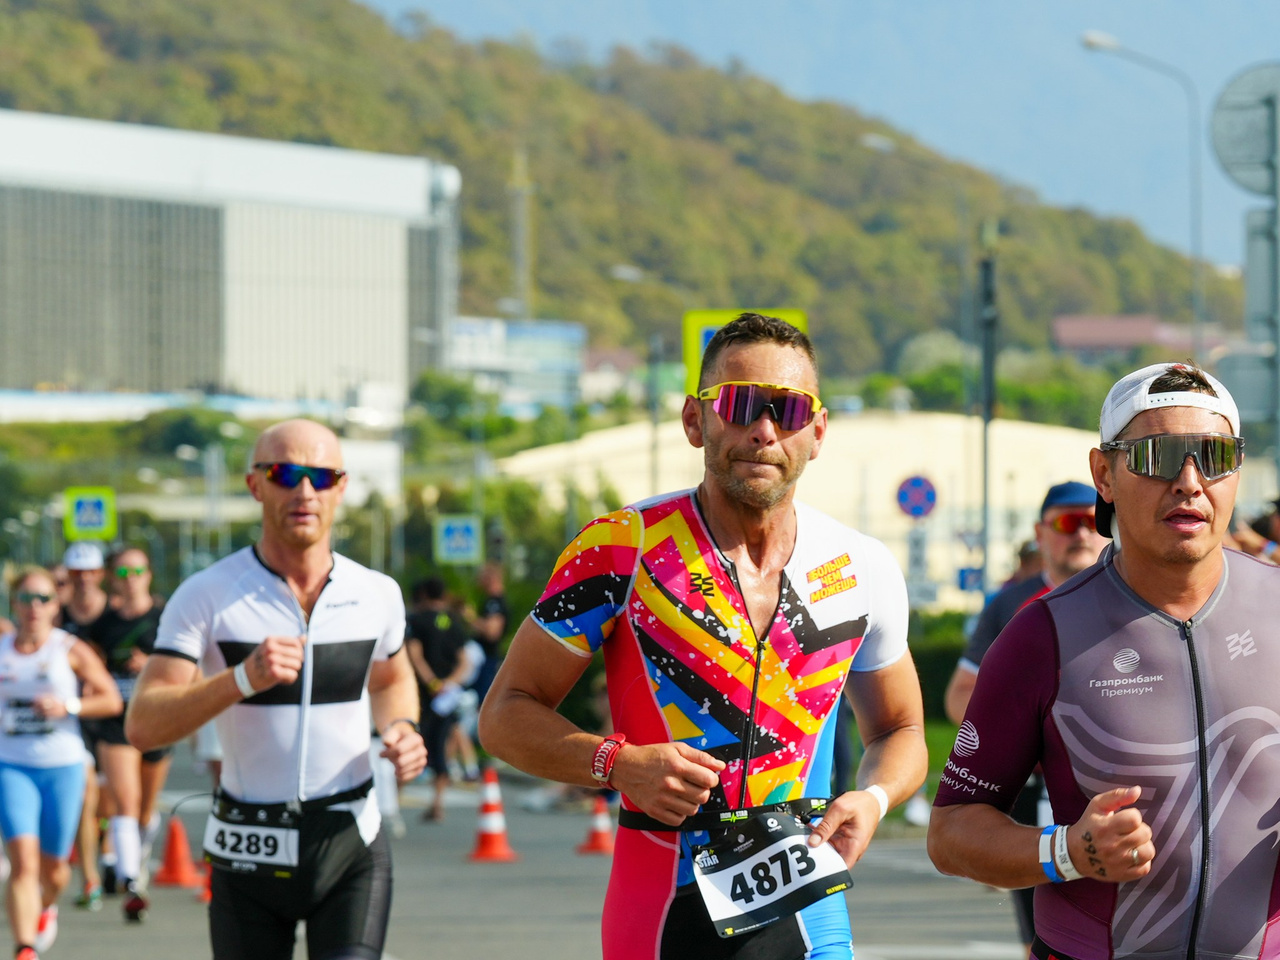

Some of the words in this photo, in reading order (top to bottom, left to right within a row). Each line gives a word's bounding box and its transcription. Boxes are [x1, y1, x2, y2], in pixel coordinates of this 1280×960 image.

[807, 553, 851, 583] БОЛЬШЕ
[820, 569, 842, 586] ЧЕМ
[810, 576, 857, 604] МОЖЕШЬ
[1089, 674, 1164, 688] Газпромбанк
[1101, 686, 1153, 698] Премиум
[214, 829, 278, 857] 4289
[697, 854, 720, 868] STAR
[730, 843, 817, 904] 4873
